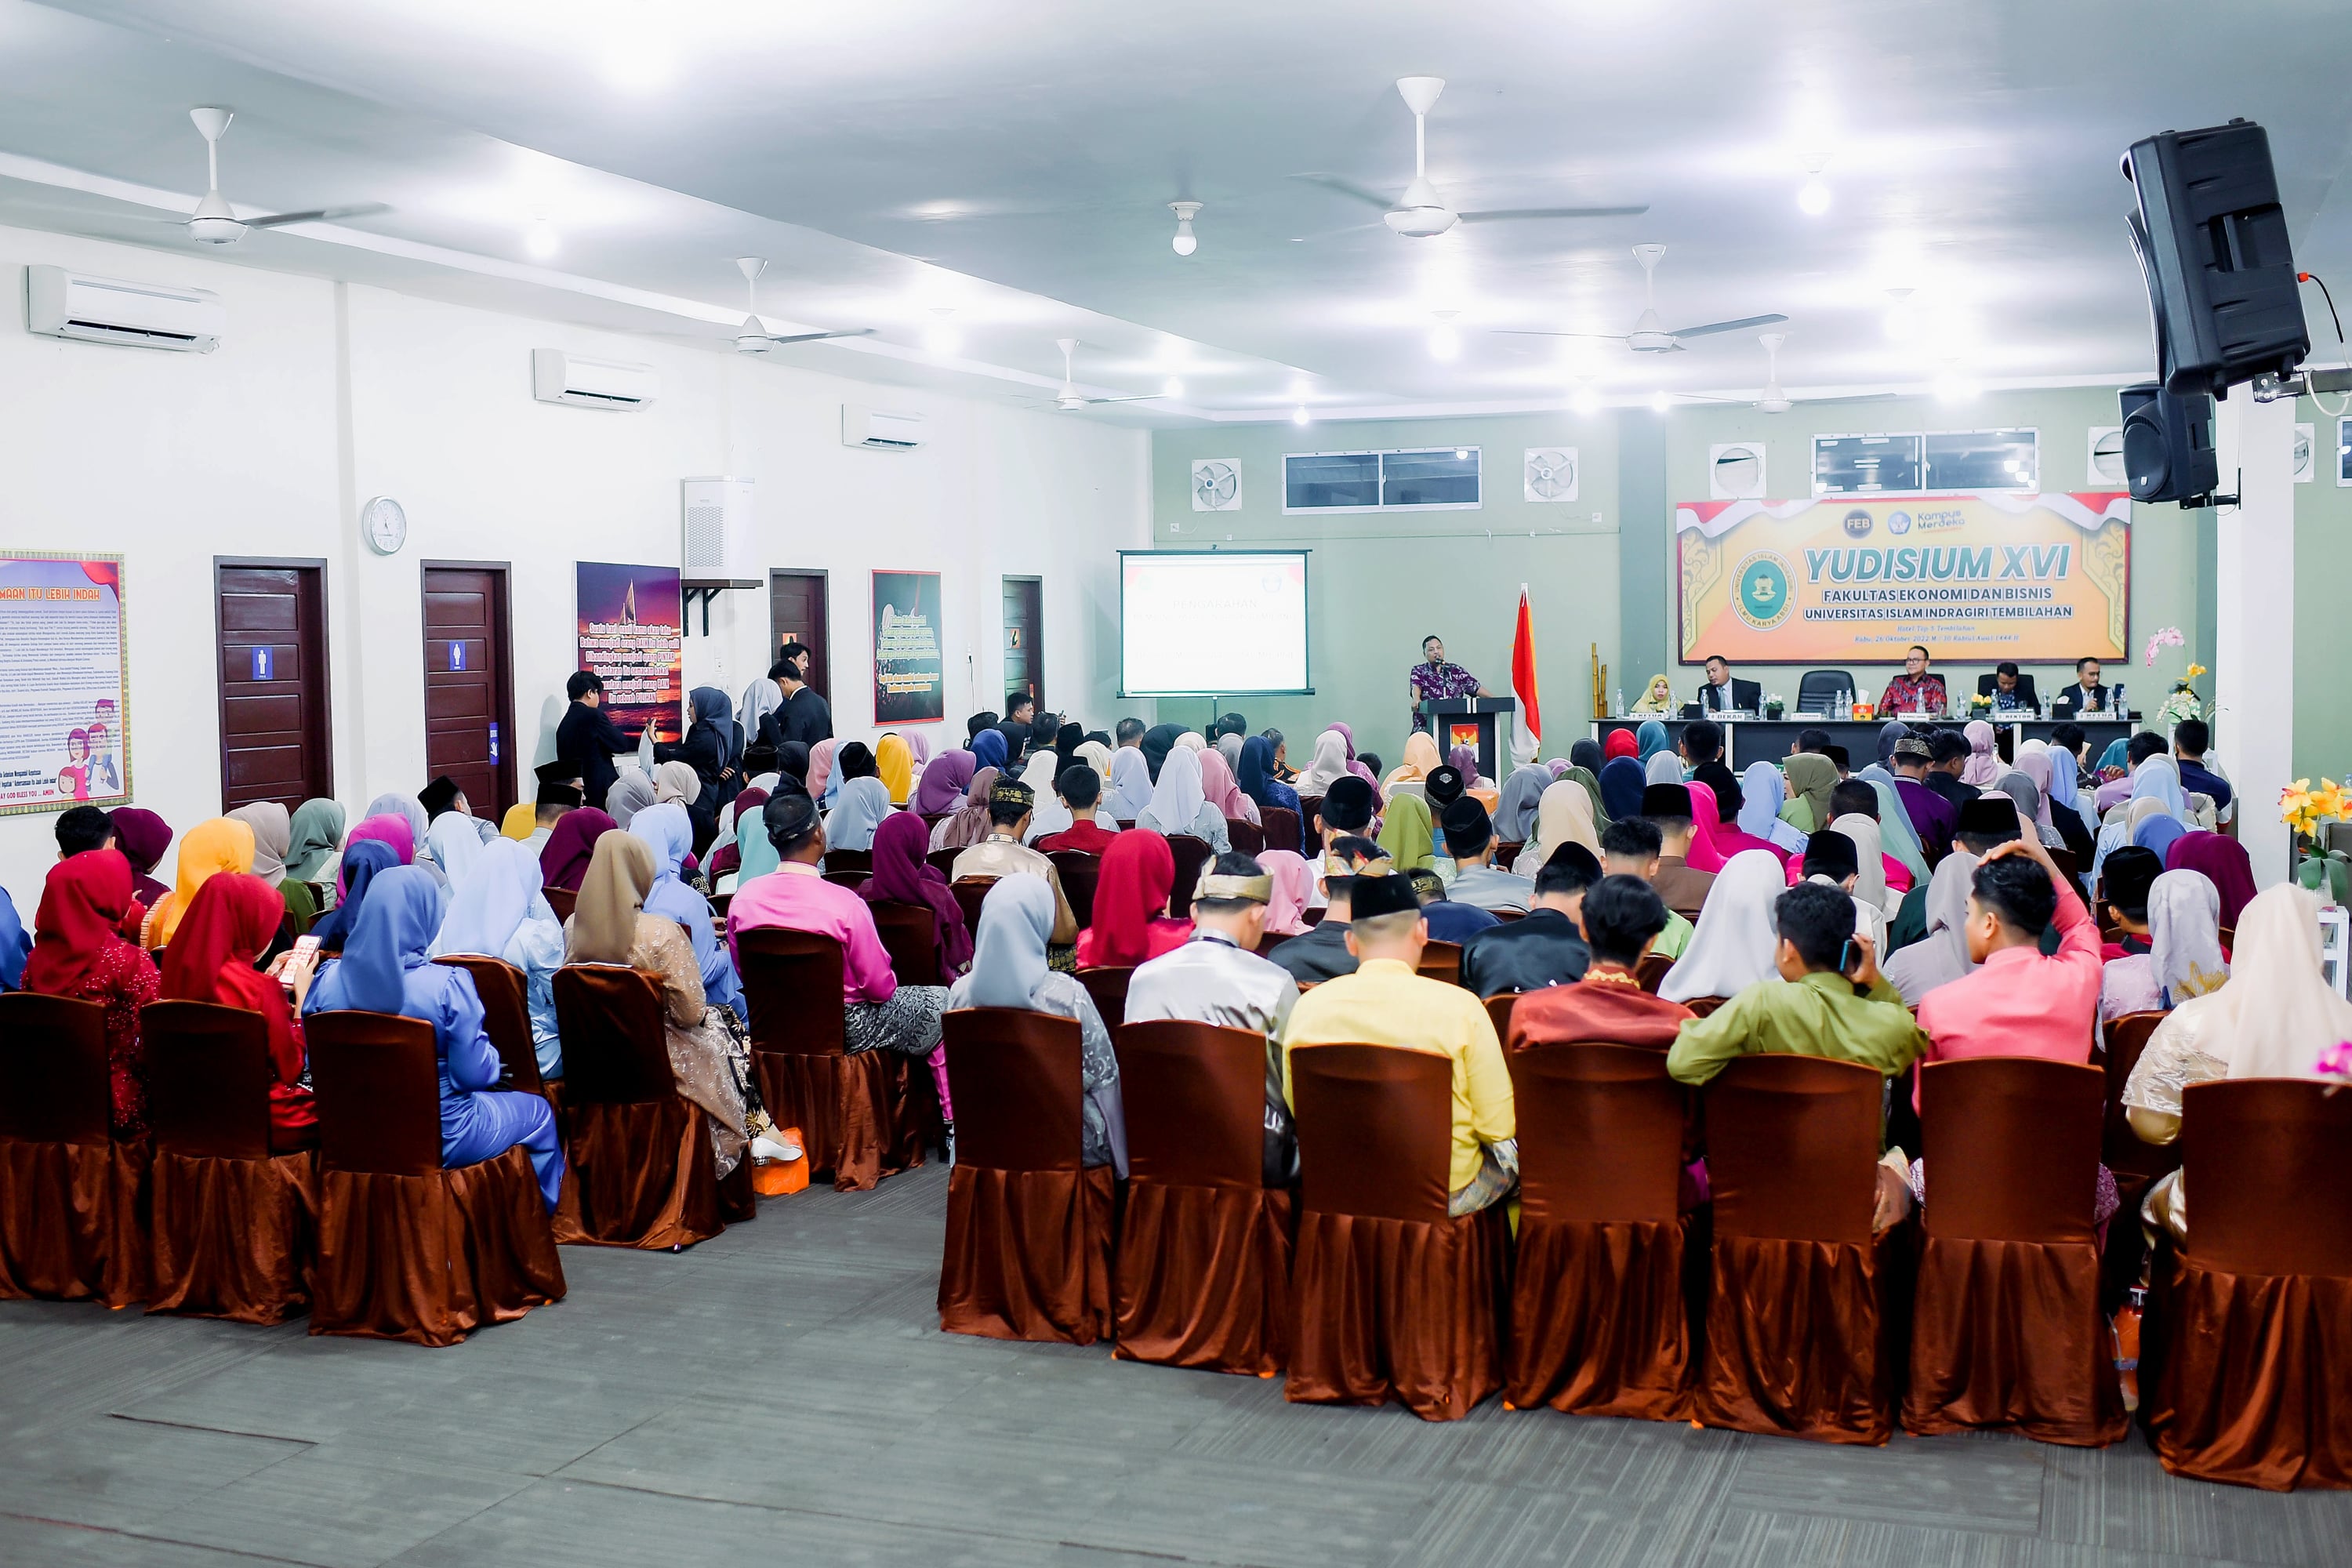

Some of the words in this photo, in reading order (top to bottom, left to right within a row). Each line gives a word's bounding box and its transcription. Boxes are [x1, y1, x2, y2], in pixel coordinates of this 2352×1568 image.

[1918, 510, 1962, 523] Kampus
[1847, 518, 1871, 529] FEB
[1918, 518, 1965, 530] Merdeka
[1805, 546, 1994, 581] YUDISIUM
[1997, 544, 2071, 579] XVI
[28, 588, 43, 600] ITU
[45, 588, 71, 600] LEBIH
[73, 588, 100, 601] INDAH
[1824, 590, 1896, 601] FAKULTAS
[1900, 589, 1967, 601] EKONOMI
[1971, 589, 2002, 600] DAN
[2005, 588, 2052, 599] BISNIS
[1738, 604, 1751, 621] ILMU
[1777, 604, 1791, 621] ABDI
[1806, 608, 1883, 619] UNIVERSITAS
[1886, 608, 1923, 618] ISLAM
[1926, 608, 1988, 618] INDRAGIRI
[1991, 606, 2072, 617] TEMBILAHAN
[590, 622, 606, 633] Suatu
[606, 623, 618, 634] hari
[580, 637, 598, 648] Bahwa
[599, 637, 621, 649] menjadi
[621, 639, 636, 649] orang
[586, 651, 622, 663] Dibandingkan
[622, 651, 642, 663] menjadi
[643, 652, 657, 663] orang
[658, 652, 675, 662] PINTAR
[631, 666, 654, 676] semacam
[655, 666, 669, 676] bakat
[622, 678, 642, 691] menjadi
[643, 681, 657, 691] orang
[657, 678, 670, 689] BAIK
[617, 692, 636, 703] sebuah
[636, 691, 656, 703] PILIHAN
